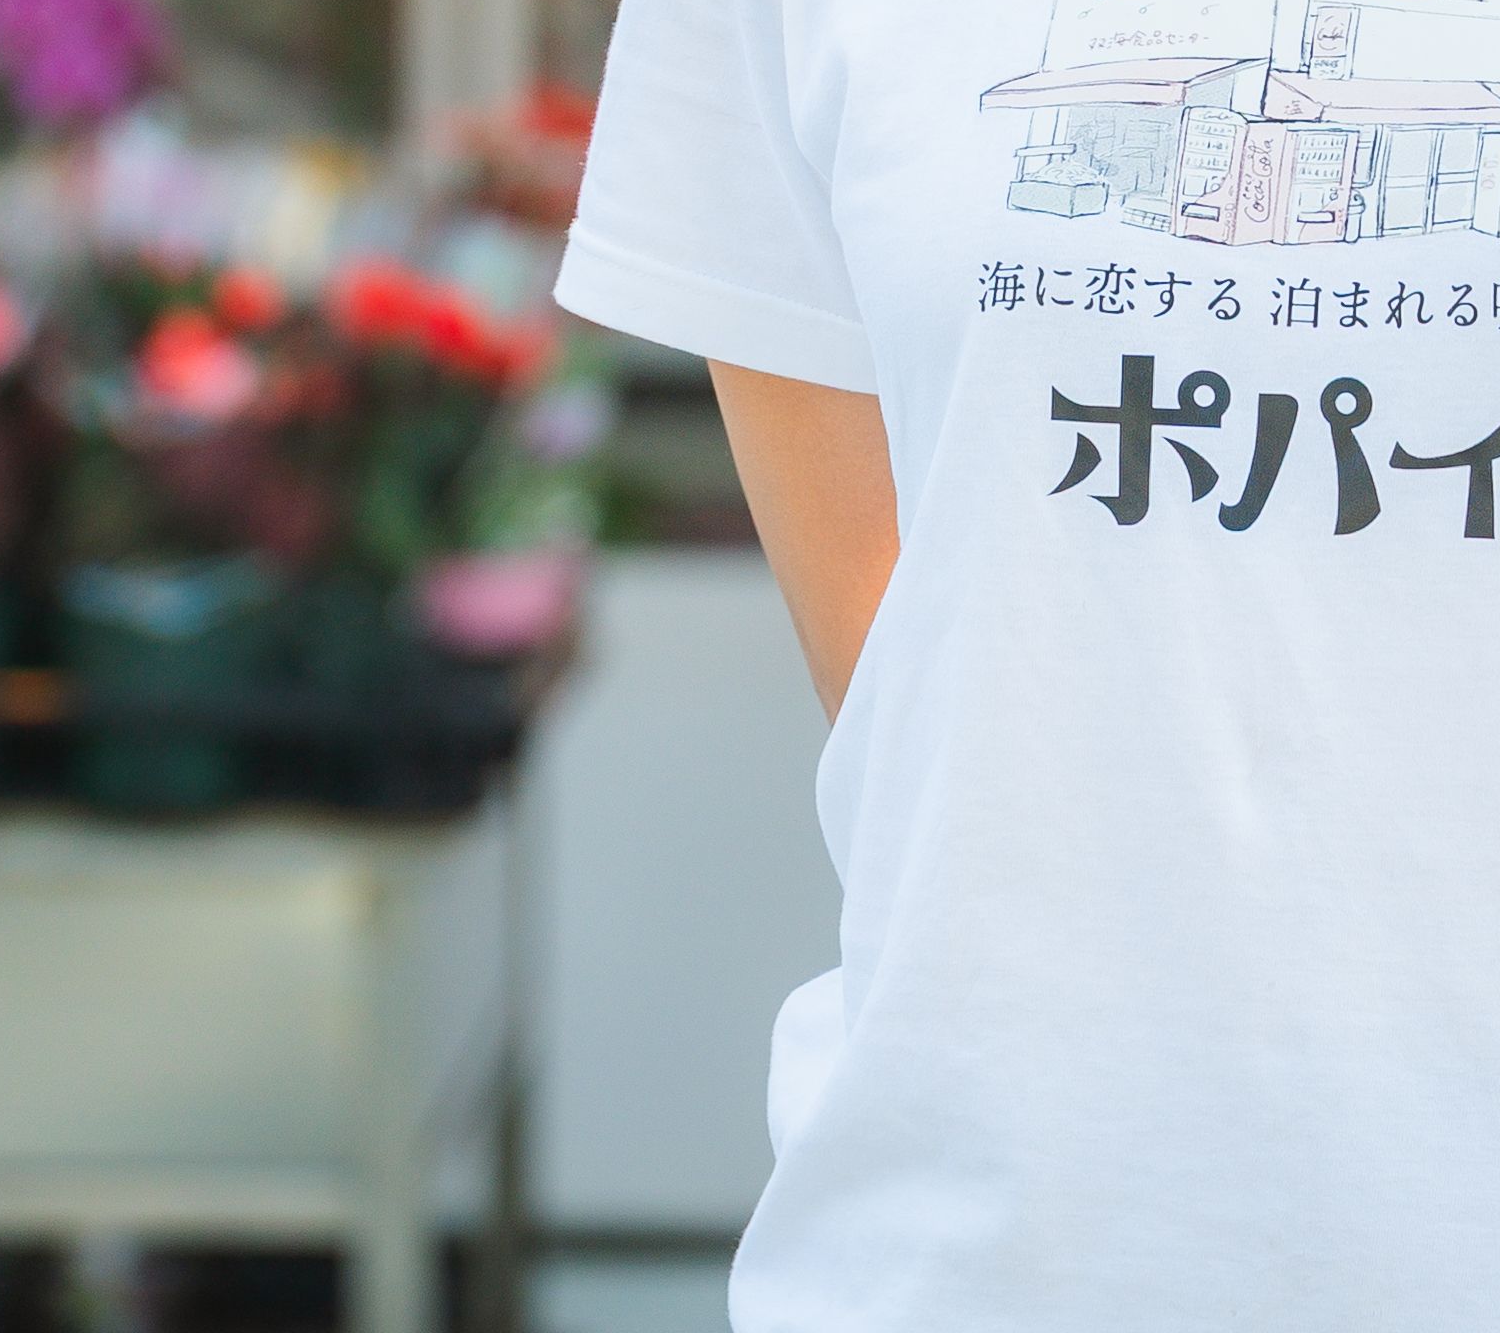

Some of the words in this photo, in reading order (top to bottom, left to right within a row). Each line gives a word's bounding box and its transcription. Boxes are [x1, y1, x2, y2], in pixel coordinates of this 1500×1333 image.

[978, 261, 1244, 322] 海に恋する
